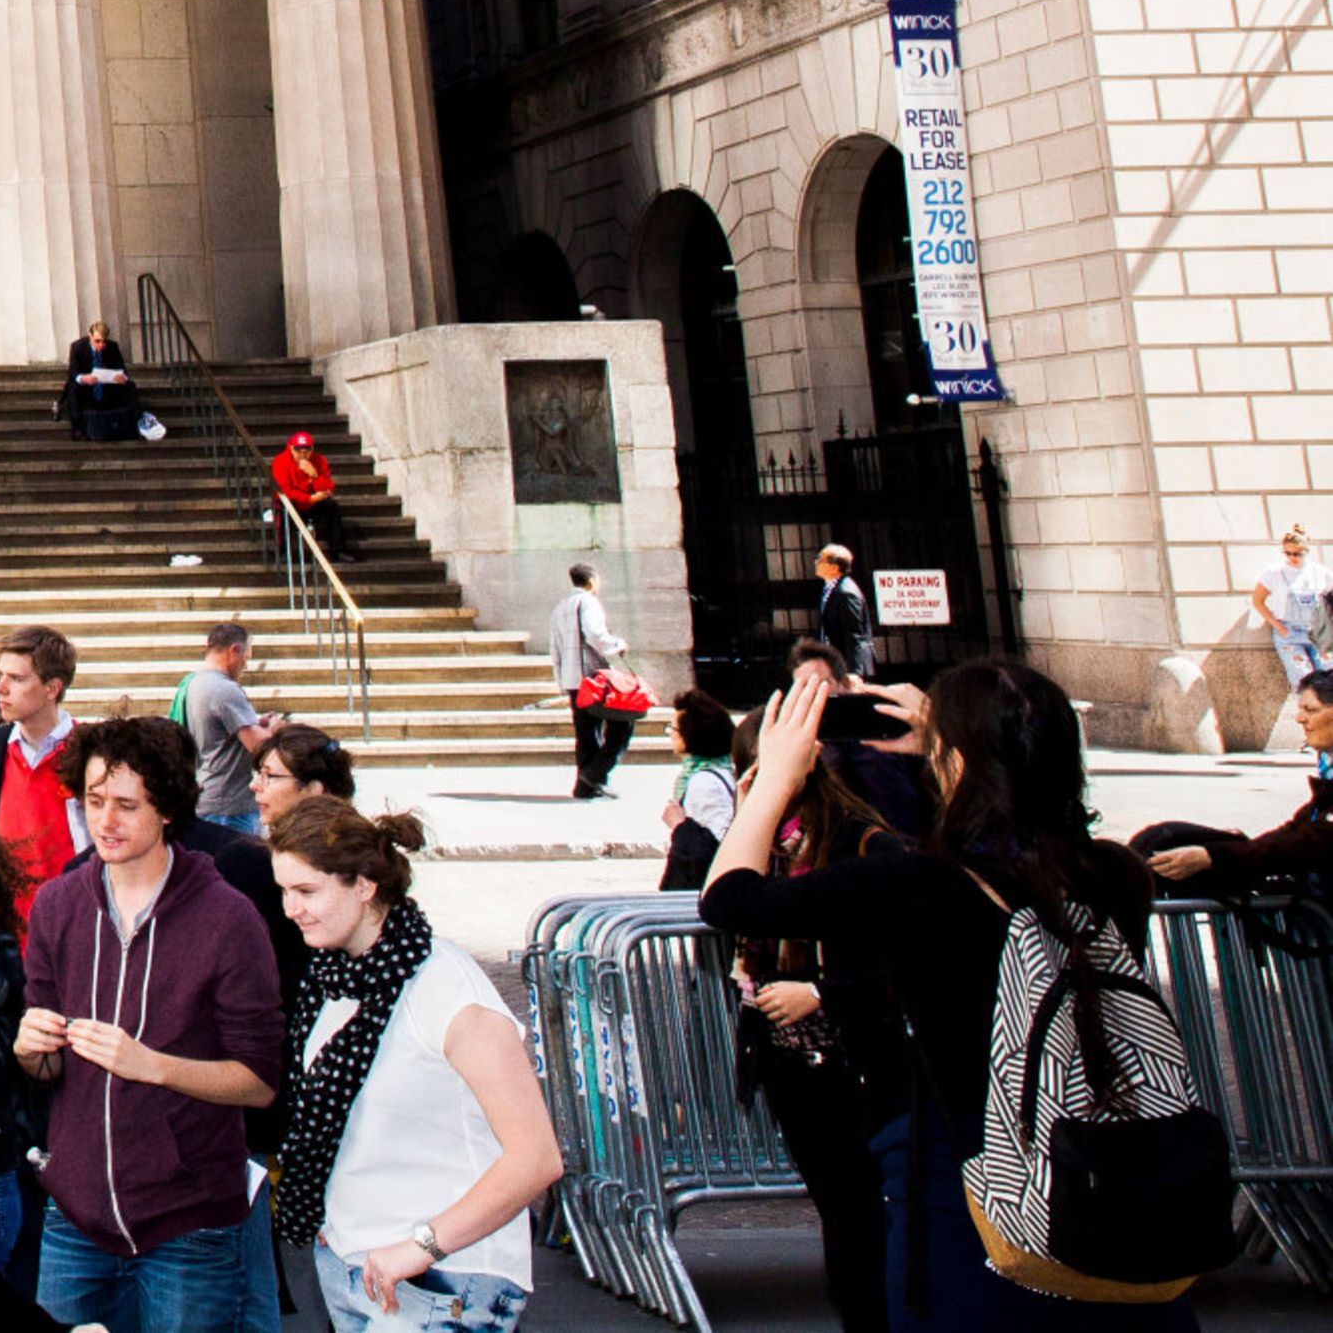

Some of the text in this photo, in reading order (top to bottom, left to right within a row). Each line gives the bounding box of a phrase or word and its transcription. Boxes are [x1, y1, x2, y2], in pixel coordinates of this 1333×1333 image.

[907, 47, 950, 78] 30
[905, 108, 962, 127] RETAIL
[919, 131, 955, 149] FOR
[909, 152, 966, 171] LEASE
[923, 181, 963, 205] 212
[925, 210, 966, 235] 792
[917, 240, 976, 265] 2600
[935, 321, 976, 353] 30
[879, 576, 940, 587] NO PARKING
